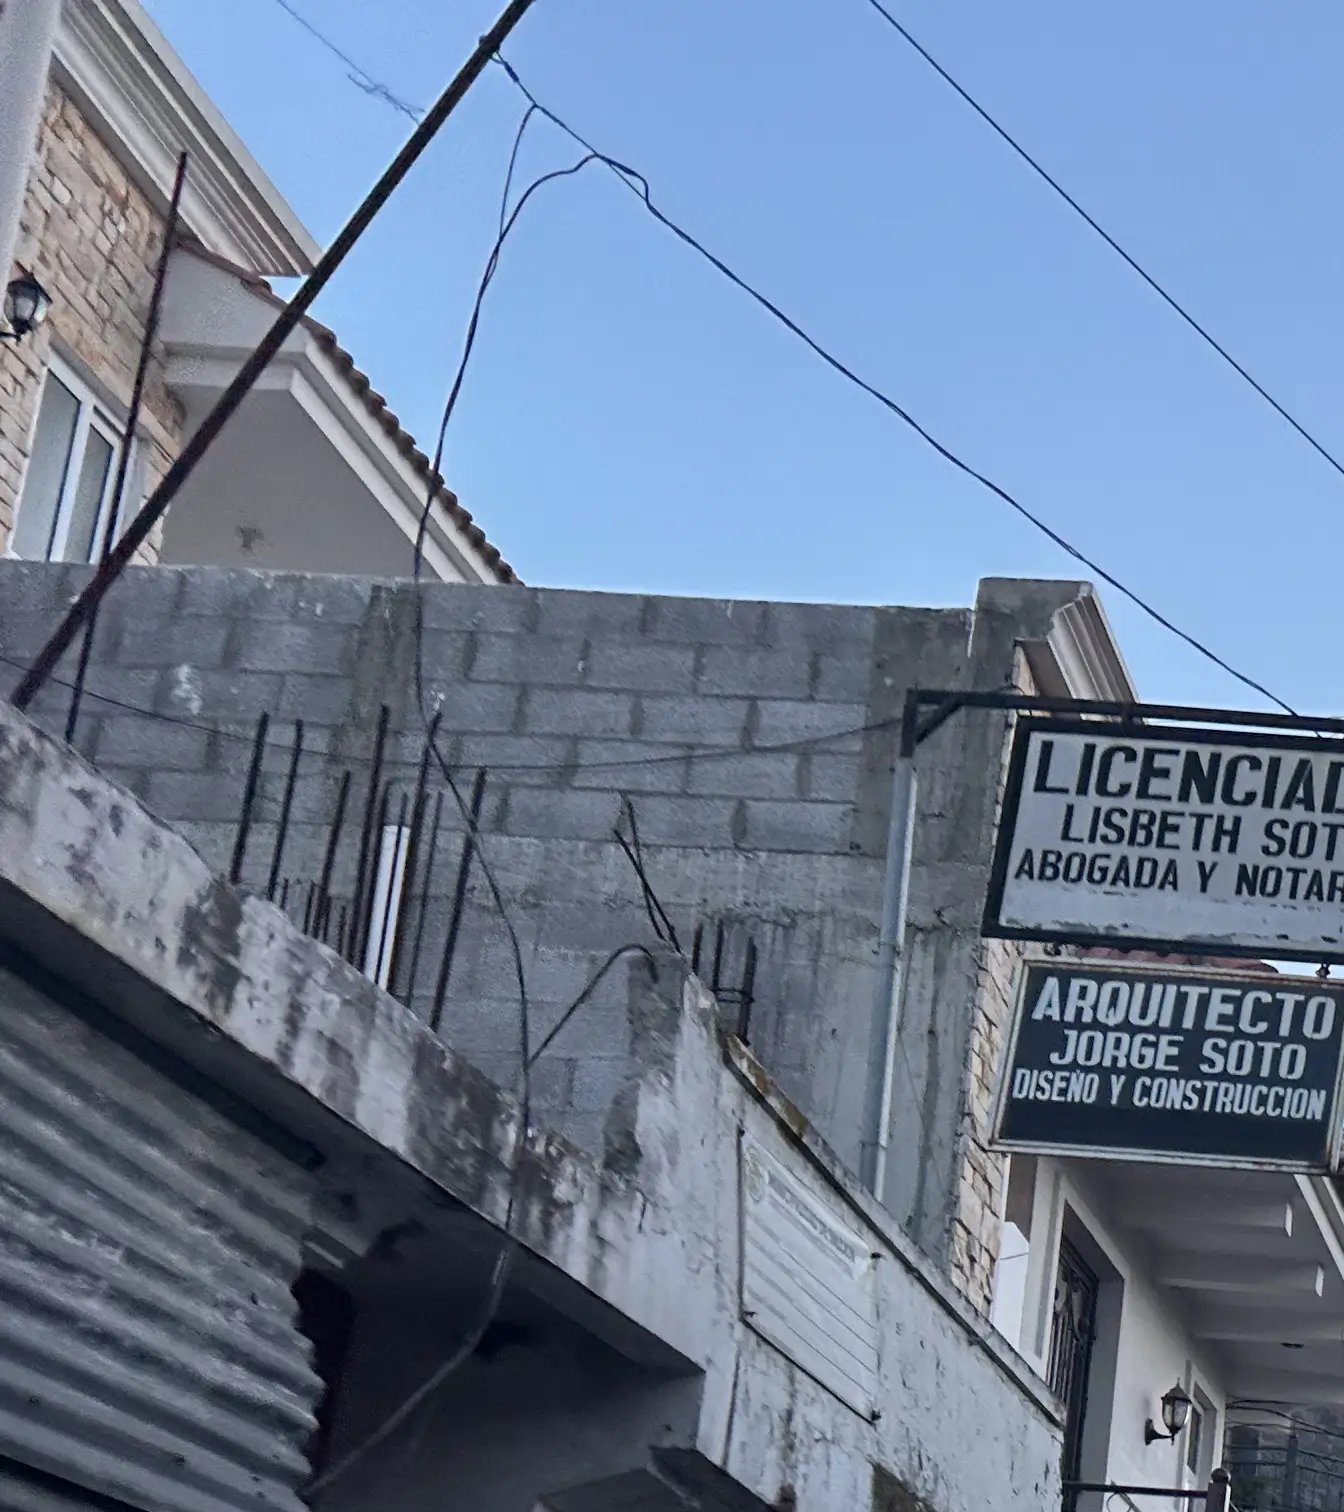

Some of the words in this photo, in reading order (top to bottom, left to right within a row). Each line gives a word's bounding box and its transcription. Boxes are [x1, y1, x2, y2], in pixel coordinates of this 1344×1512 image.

[1061, 803, 1242, 855] LISBETH
[1014, 847, 1179, 892] ABOGADA
[1197, 861, 1219, 894] Y
[1031, 976, 1337, 1040] ARQUITECTO
[1049, 1029, 1184, 1072] JORGE
[1199, 1037, 1307, 1080] SOTO
[1110, 1074, 1124, 1105] Y
[1133, 1076, 1327, 1120] CONSTRUCCION
